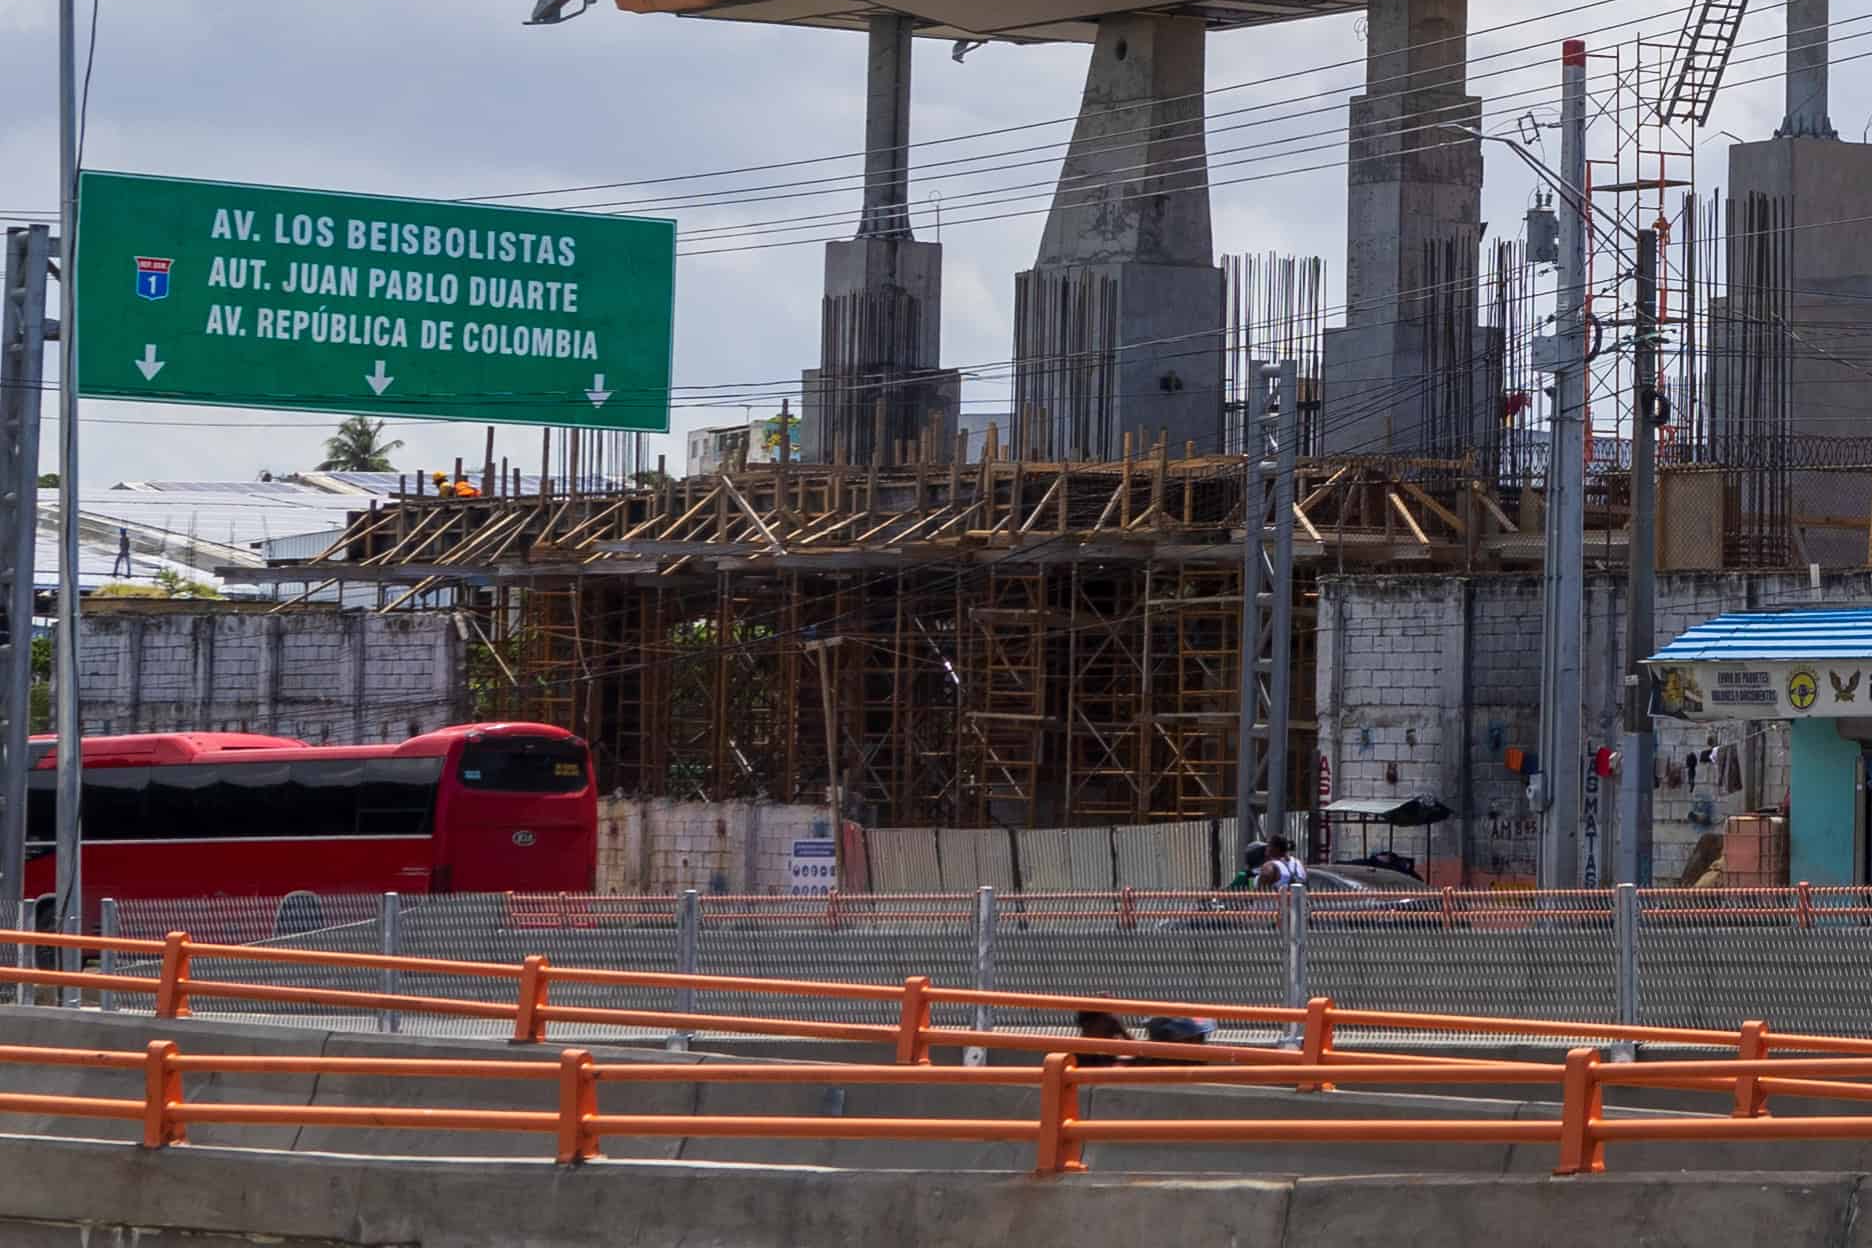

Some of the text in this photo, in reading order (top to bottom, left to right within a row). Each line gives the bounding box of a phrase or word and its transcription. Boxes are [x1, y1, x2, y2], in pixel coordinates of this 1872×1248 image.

[211, 209, 576, 267] AV. LOS BEISBOLISTAS
[148, 275, 157, 294] 1
[208, 257, 578, 313] AUT. JUAN PABLO DUARTE
[206, 305, 598, 360] AV. REPÚBLICA DE COLOMBIA
